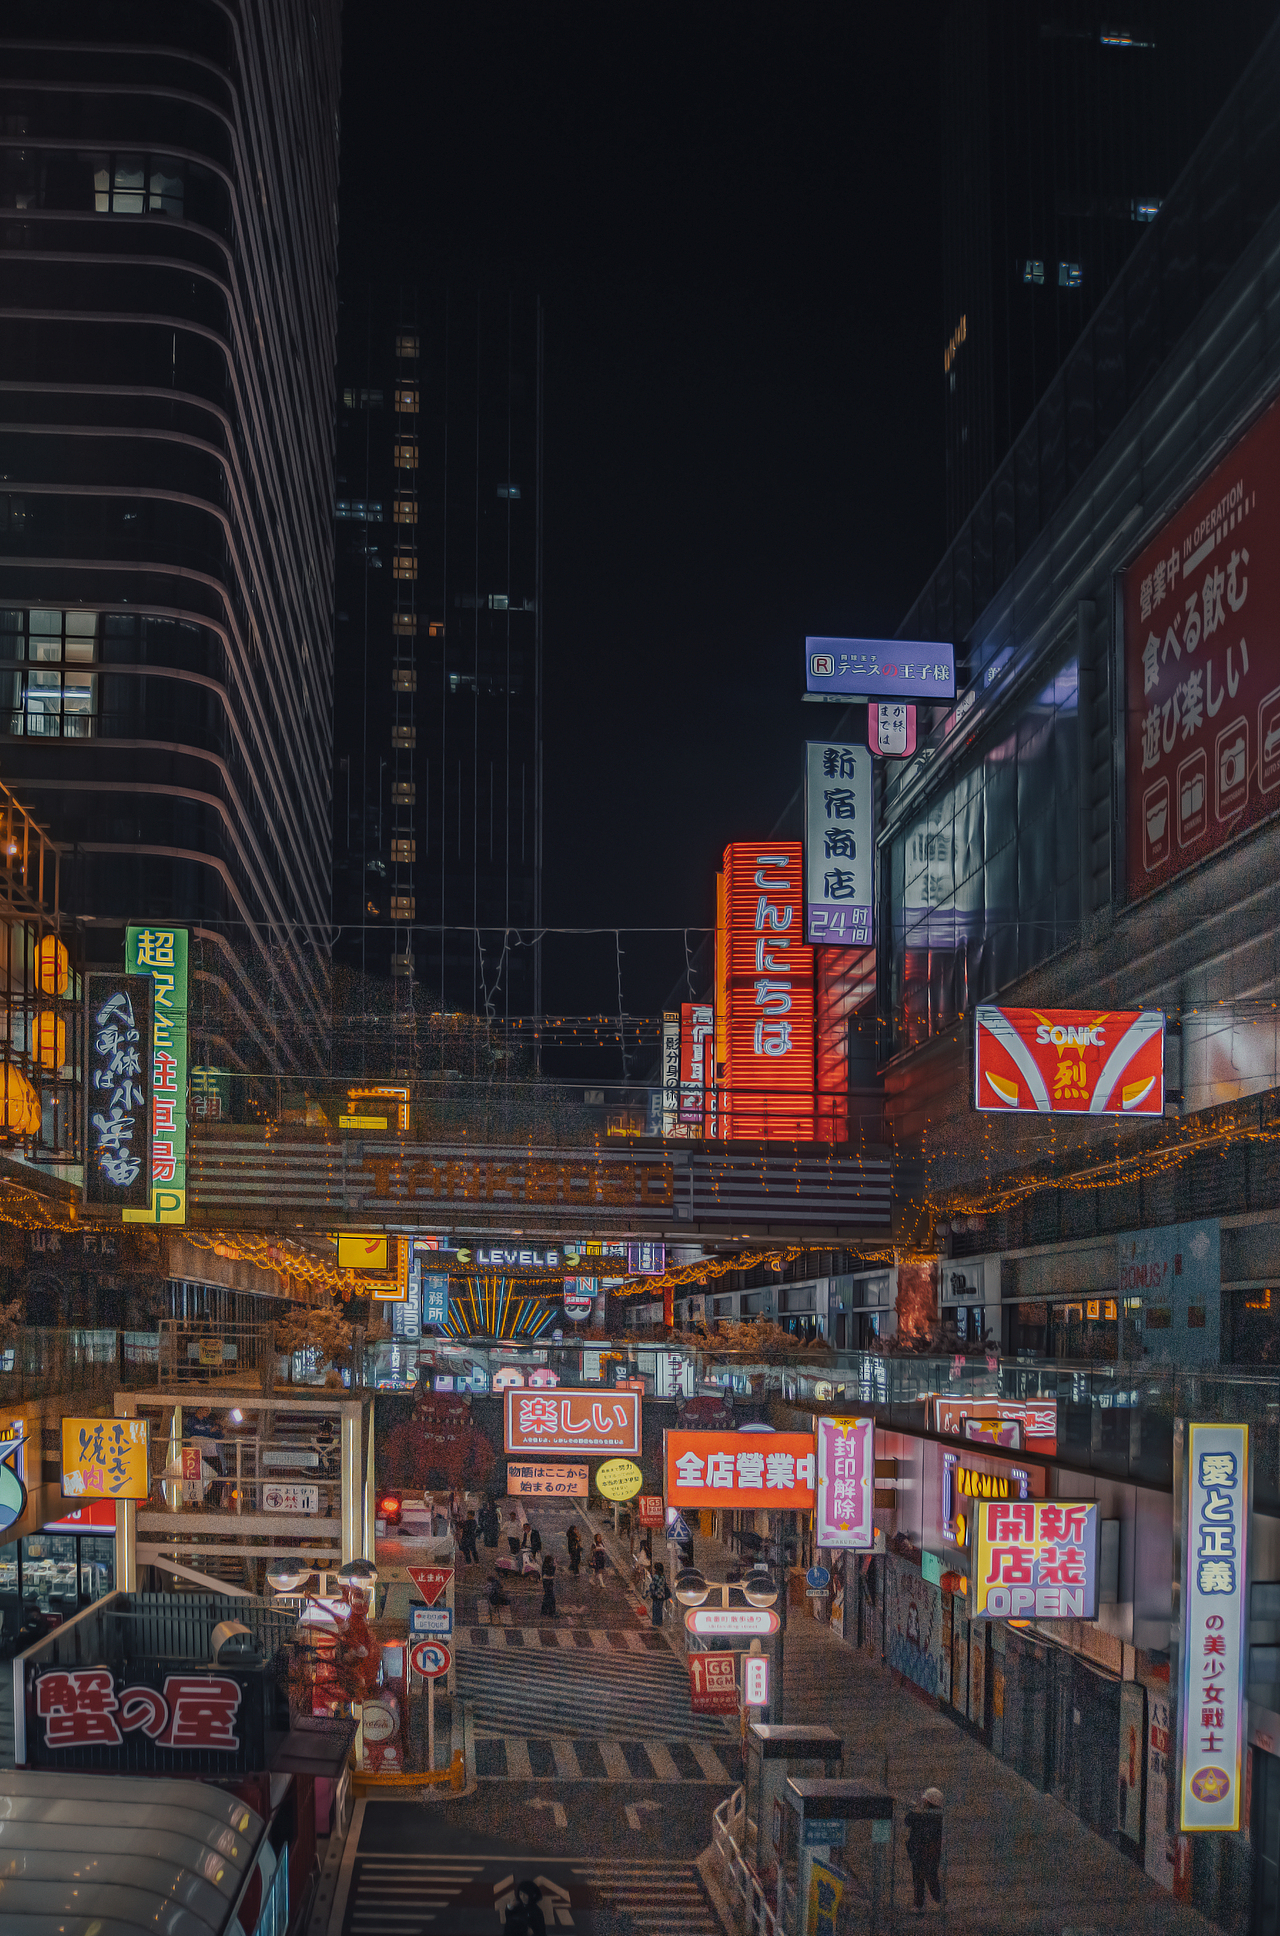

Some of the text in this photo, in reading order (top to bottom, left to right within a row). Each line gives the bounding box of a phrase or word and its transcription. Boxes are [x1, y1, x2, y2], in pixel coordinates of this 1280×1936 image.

[1183, 478, 1243, 558] IN OPERATION
[1141, 547, 1250, 697] 食べる飲む
[816, 657, 829, 673] R
[838, 662, 950, 681] テニスの王子様
[1140, 637, 1249, 775] 遊び楽しい
[823, 747, 857, 900] 新宿商店
[809, 909, 846, 937] 24
[753, 855, 793, 1058] こんにちは
[1034, 1024, 1105, 1046] SONIC
[1052, 1060, 1089, 1100] 烈
[154, 1192, 180, 1223] P
[519, 1397, 628, 1434] 楽しい
[107, 1424, 132, 1493] ホルモン
[520, 1480, 578, 1493] 始まるのだ
[832, 1435, 856, 1520] 封印解除
[1197, 1451, 1236, 1596] 愛と正義
[417, 1572, 444, 1582] 止まれ
[986, 1587, 1085, 1618] OPEN
[419, 1621, 443, 1629] DETOUR
[708, 1661, 731, 1675] G6
[36, 1670, 242, 1750] 蟹の屋
